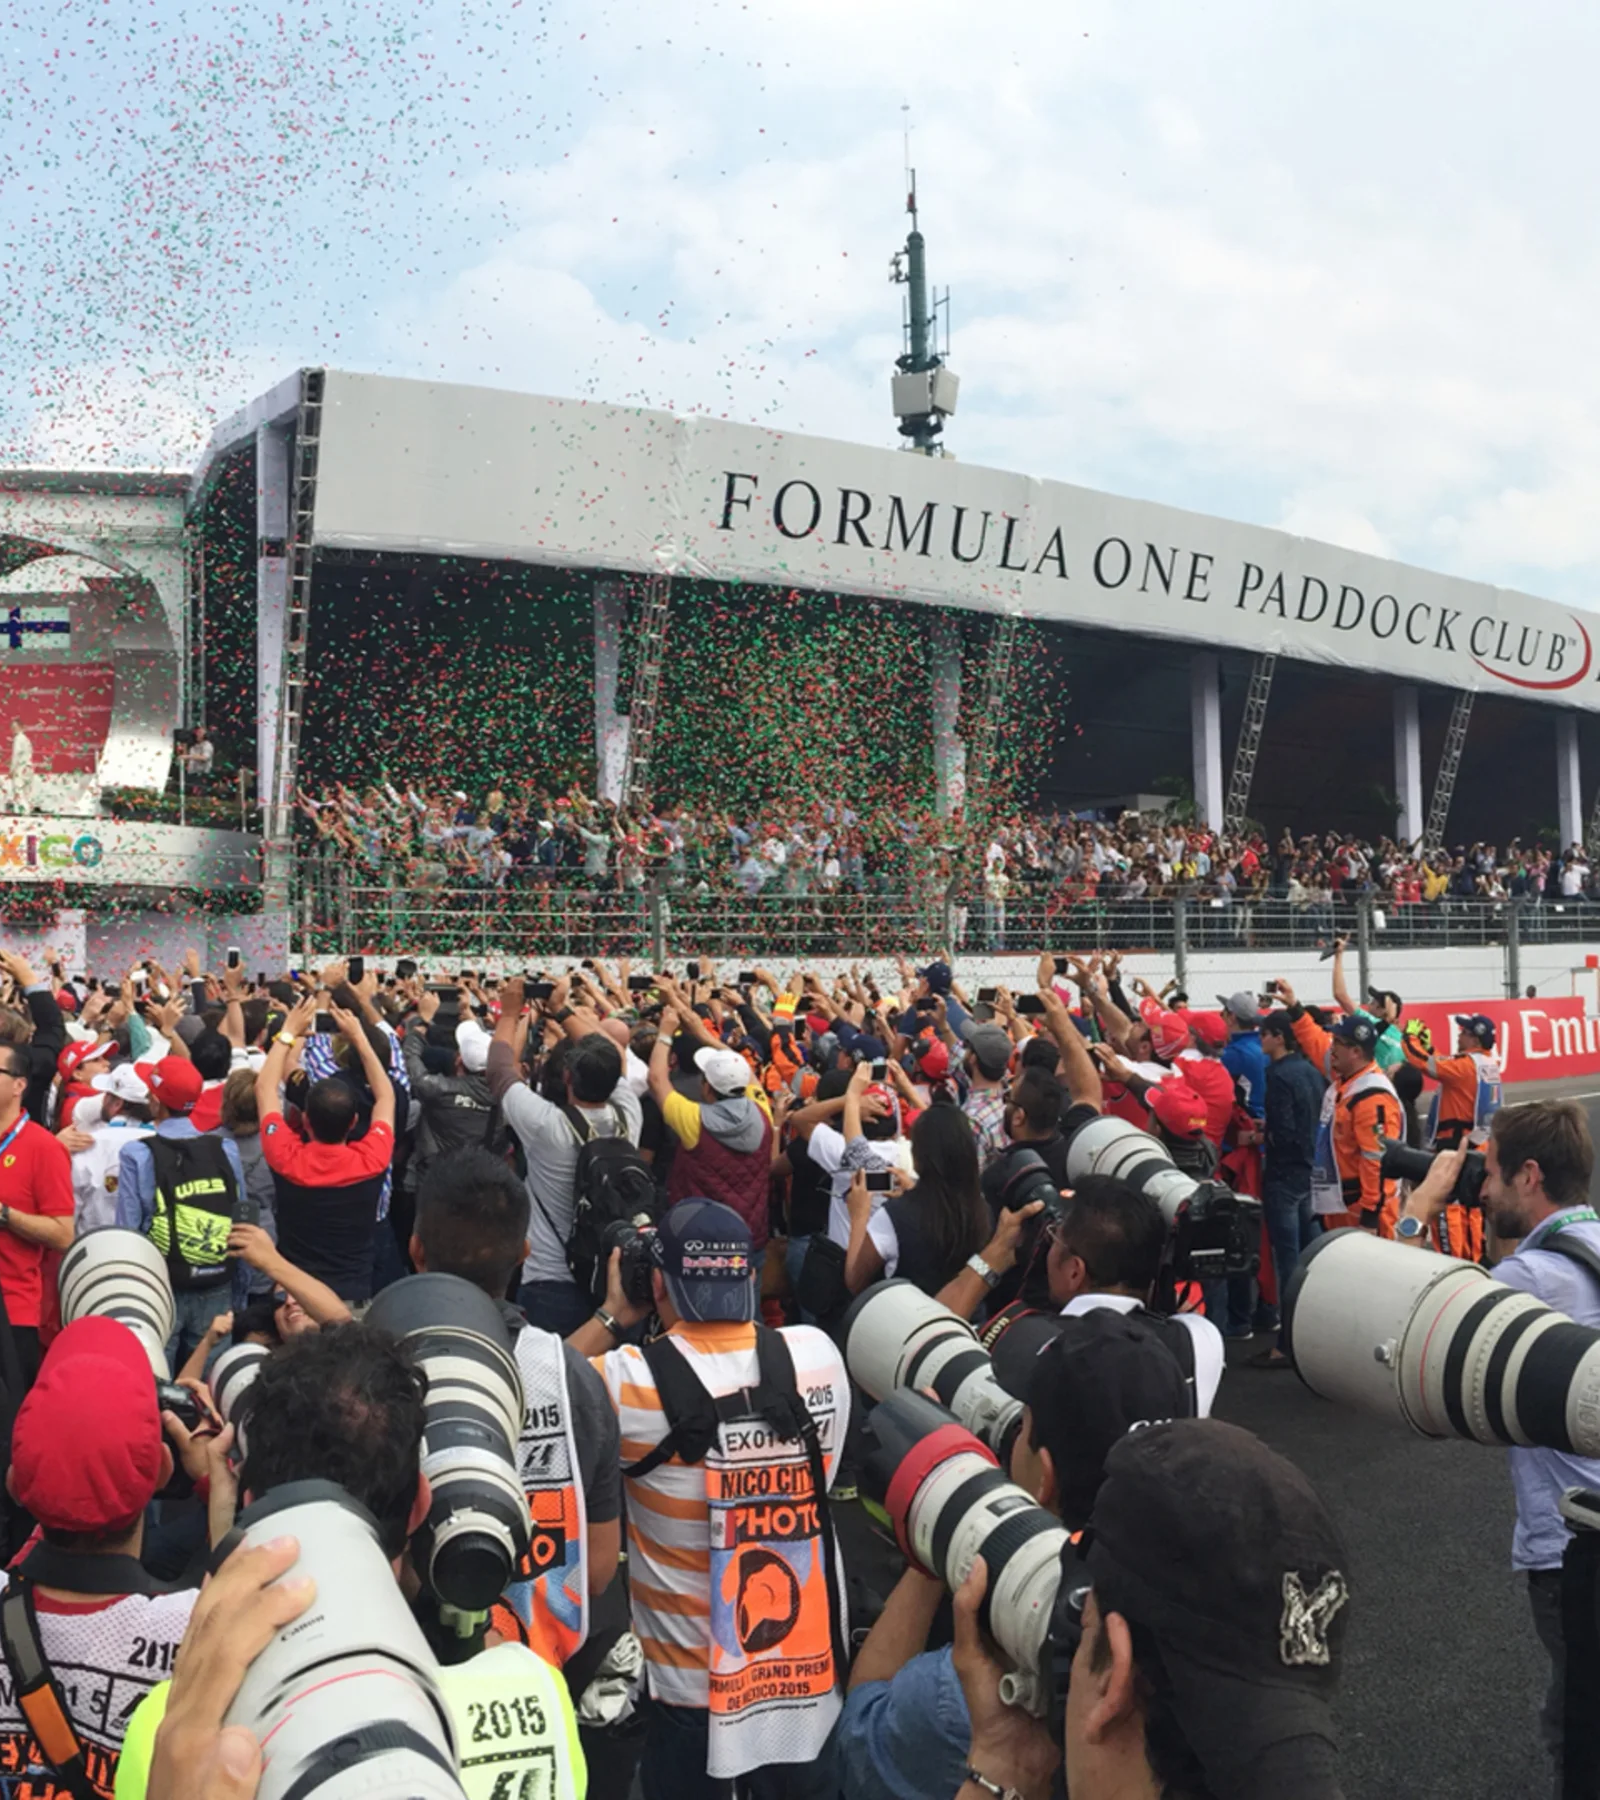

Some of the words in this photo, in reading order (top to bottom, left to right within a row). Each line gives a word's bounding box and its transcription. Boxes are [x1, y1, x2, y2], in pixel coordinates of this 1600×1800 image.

[716, 471, 1069, 579] FORMULA
[1093, 537, 1214, 602] ONE
[1234, 561, 1463, 652] PADDOCK
[467, 1695, 546, 1743] 2015
